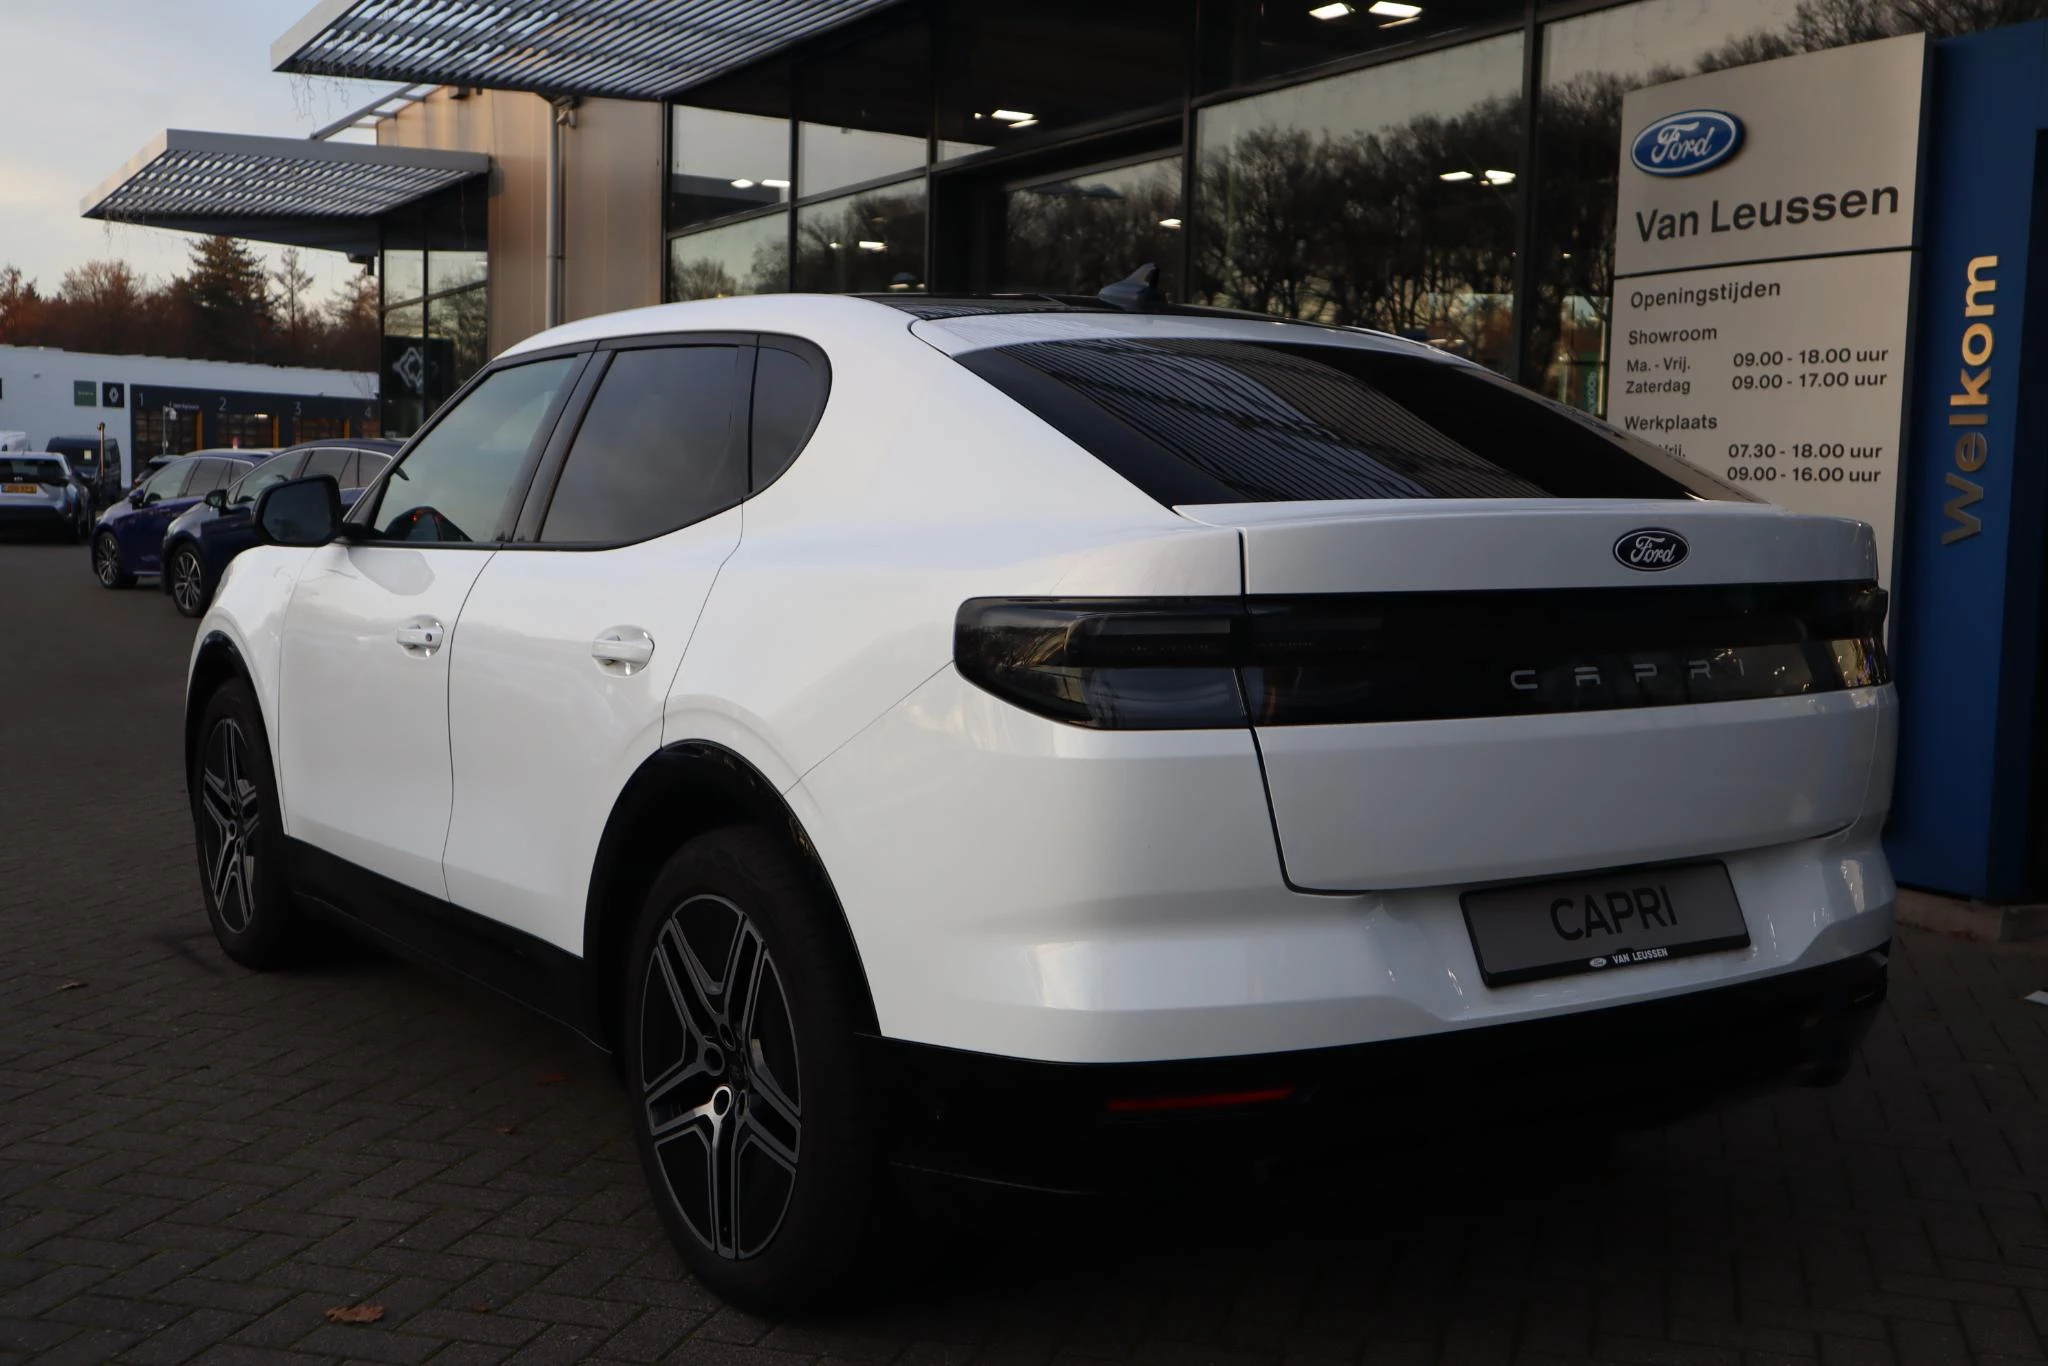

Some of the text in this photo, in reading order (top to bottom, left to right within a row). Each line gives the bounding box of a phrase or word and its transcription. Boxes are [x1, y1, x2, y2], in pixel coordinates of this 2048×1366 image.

[1650, 121, 1715, 165] Ford
[1636, 184, 1899, 242] Van Leussen
[1630, 280, 1781, 311] Openingstijden
[1628, 326, 1718, 345] Showroom
[1626, 359, 1651, 372] Ma.
[1663, 356, 1691, 374] Vrij.
[1733, 350, 1783, 367] 09.00
[1799, 348, 1851, 364] 18.00
[1856, 347, 1889, 362] uur
[1625, 379, 1691, 395] Zaterdag
[1732, 374, 1782, 390] 09.00
[1798, 372, 1849, 388] 17.00
[1854, 372, 1887, 386] uur
[1940, 255, 1998, 545] Welkom
[1625, 414, 1718, 432] Werkplaats
[1728, 443, 1776, 459] 07.30
[1792, 443, 1845, 458] 18.00
[1850, 444, 1882, 458] uur
[1727, 466, 1777, 482] 09.00
[1792, 466, 1844, 482] 16.00
[1849, 468, 1881, 482] uur
[1629, 535, 1676, 564] Ford
[1509, 658, 1745, 691] CAPRI
[1550, 885, 1679, 941] CAPRI
[1611, 952, 1631, 964] VAN
[1632, 947, 1669, 961] LEUSSEN
